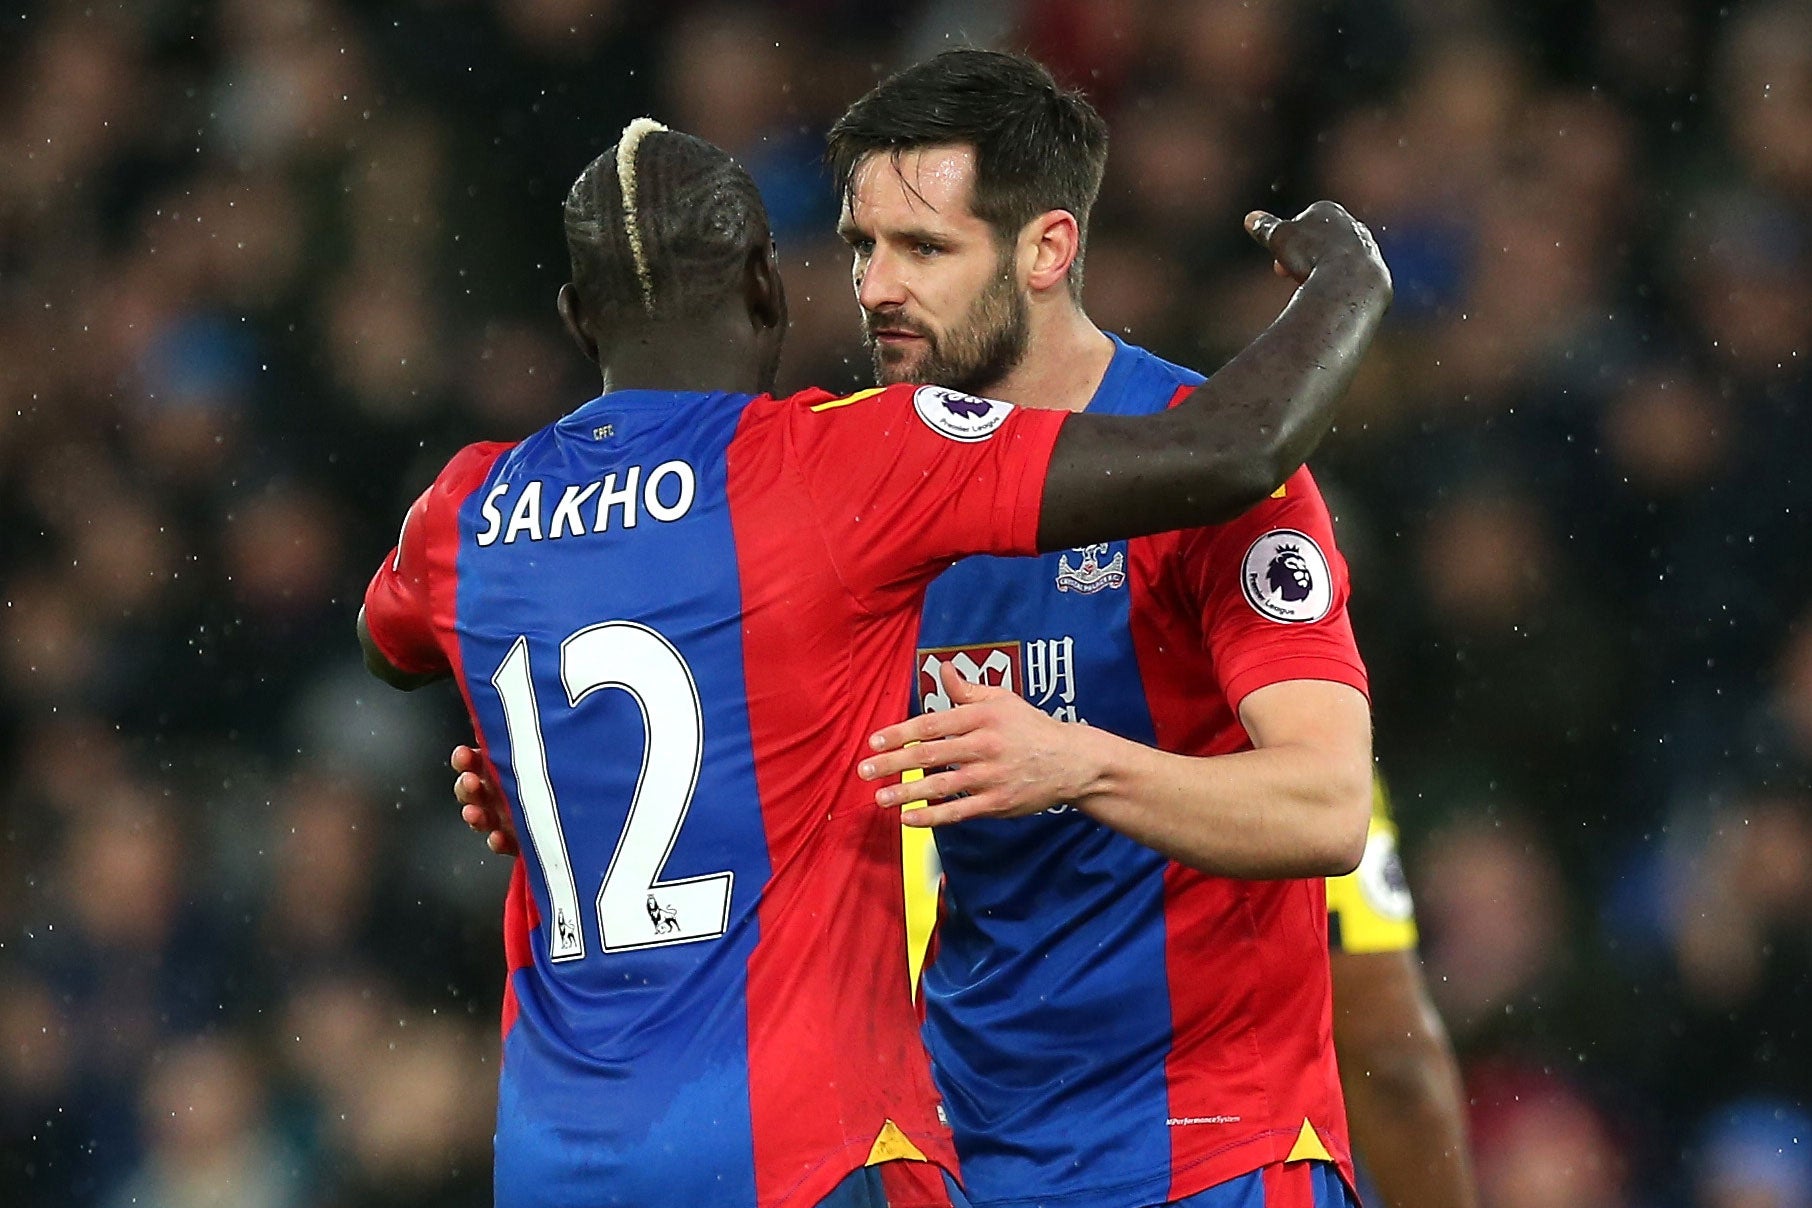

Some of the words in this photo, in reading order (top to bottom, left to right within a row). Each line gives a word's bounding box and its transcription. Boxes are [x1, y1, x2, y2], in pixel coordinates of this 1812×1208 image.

[939, 417, 970, 433] Premier
[971, 416, 1000, 433] League
[475, 458, 697, 548] SAKHO
[1249, 571, 1265, 601] Premier
[1264, 598, 1296, 615] League
[491, 620, 734, 962] 12
